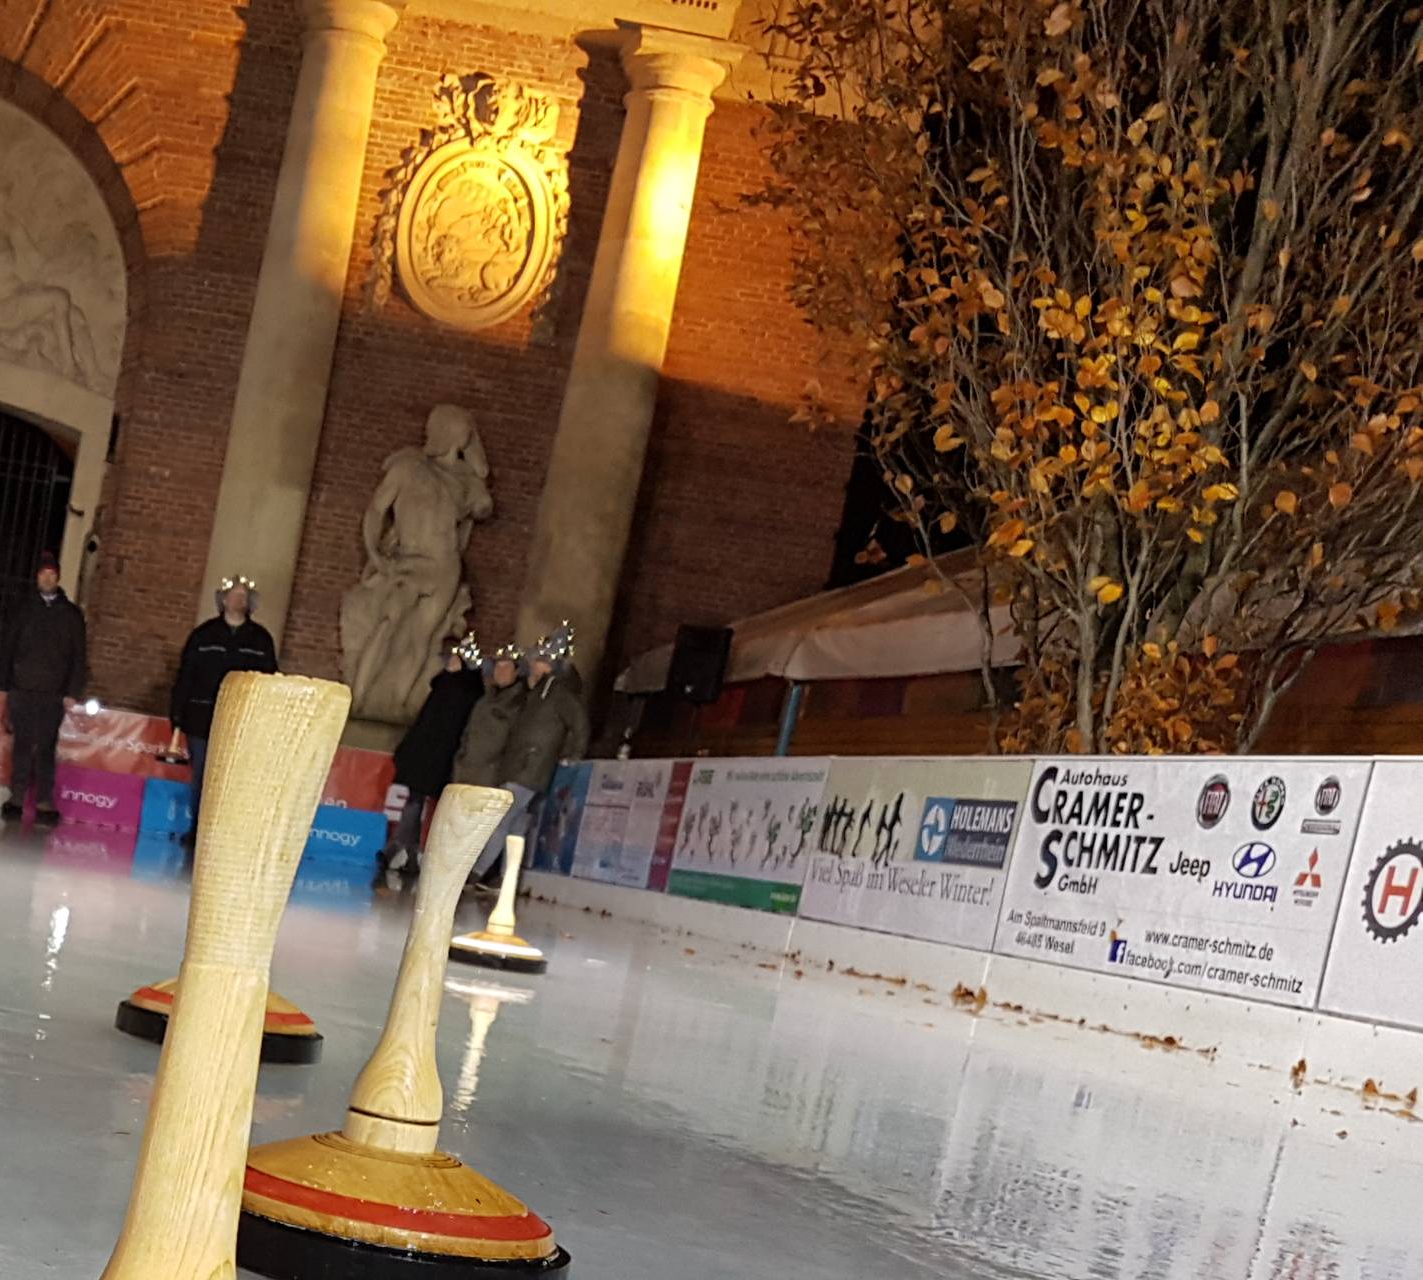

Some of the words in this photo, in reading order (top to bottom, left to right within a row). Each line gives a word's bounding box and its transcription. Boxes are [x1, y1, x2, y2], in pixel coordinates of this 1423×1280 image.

[1059, 767, 1129, 787] Autohaus
[61, 787, 117, 809] innogy
[1031, 766, 1155, 829] CRAMER-
[950, 804, 1014, 833] HOLEMANS
[310, 828, 361, 847] nnogy
[1034, 829, 1165, 889] SCHMITZ
[1169, 851, 1211, 882] Jeep
[810, 857, 832, 882] Viel
[836, 861, 865, 893] Spaß
[867, 869, 884, 890] im
[887, 867, 936, 897] Weseler
[940, 871, 995, 906] Winter!
[1058, 874, 1098, 895] GmbH
[1212, 881, 1279, 903] HYUNDAI
[1377, 865, 1419, 916] H
[1007, 909, 1023, 924] Am
[1099, 921, 1107, 938] 9
[1044, 935, 1075, 954] Wesel
[1145, 930, 1274, 961] www.cramer-schmitz.de
